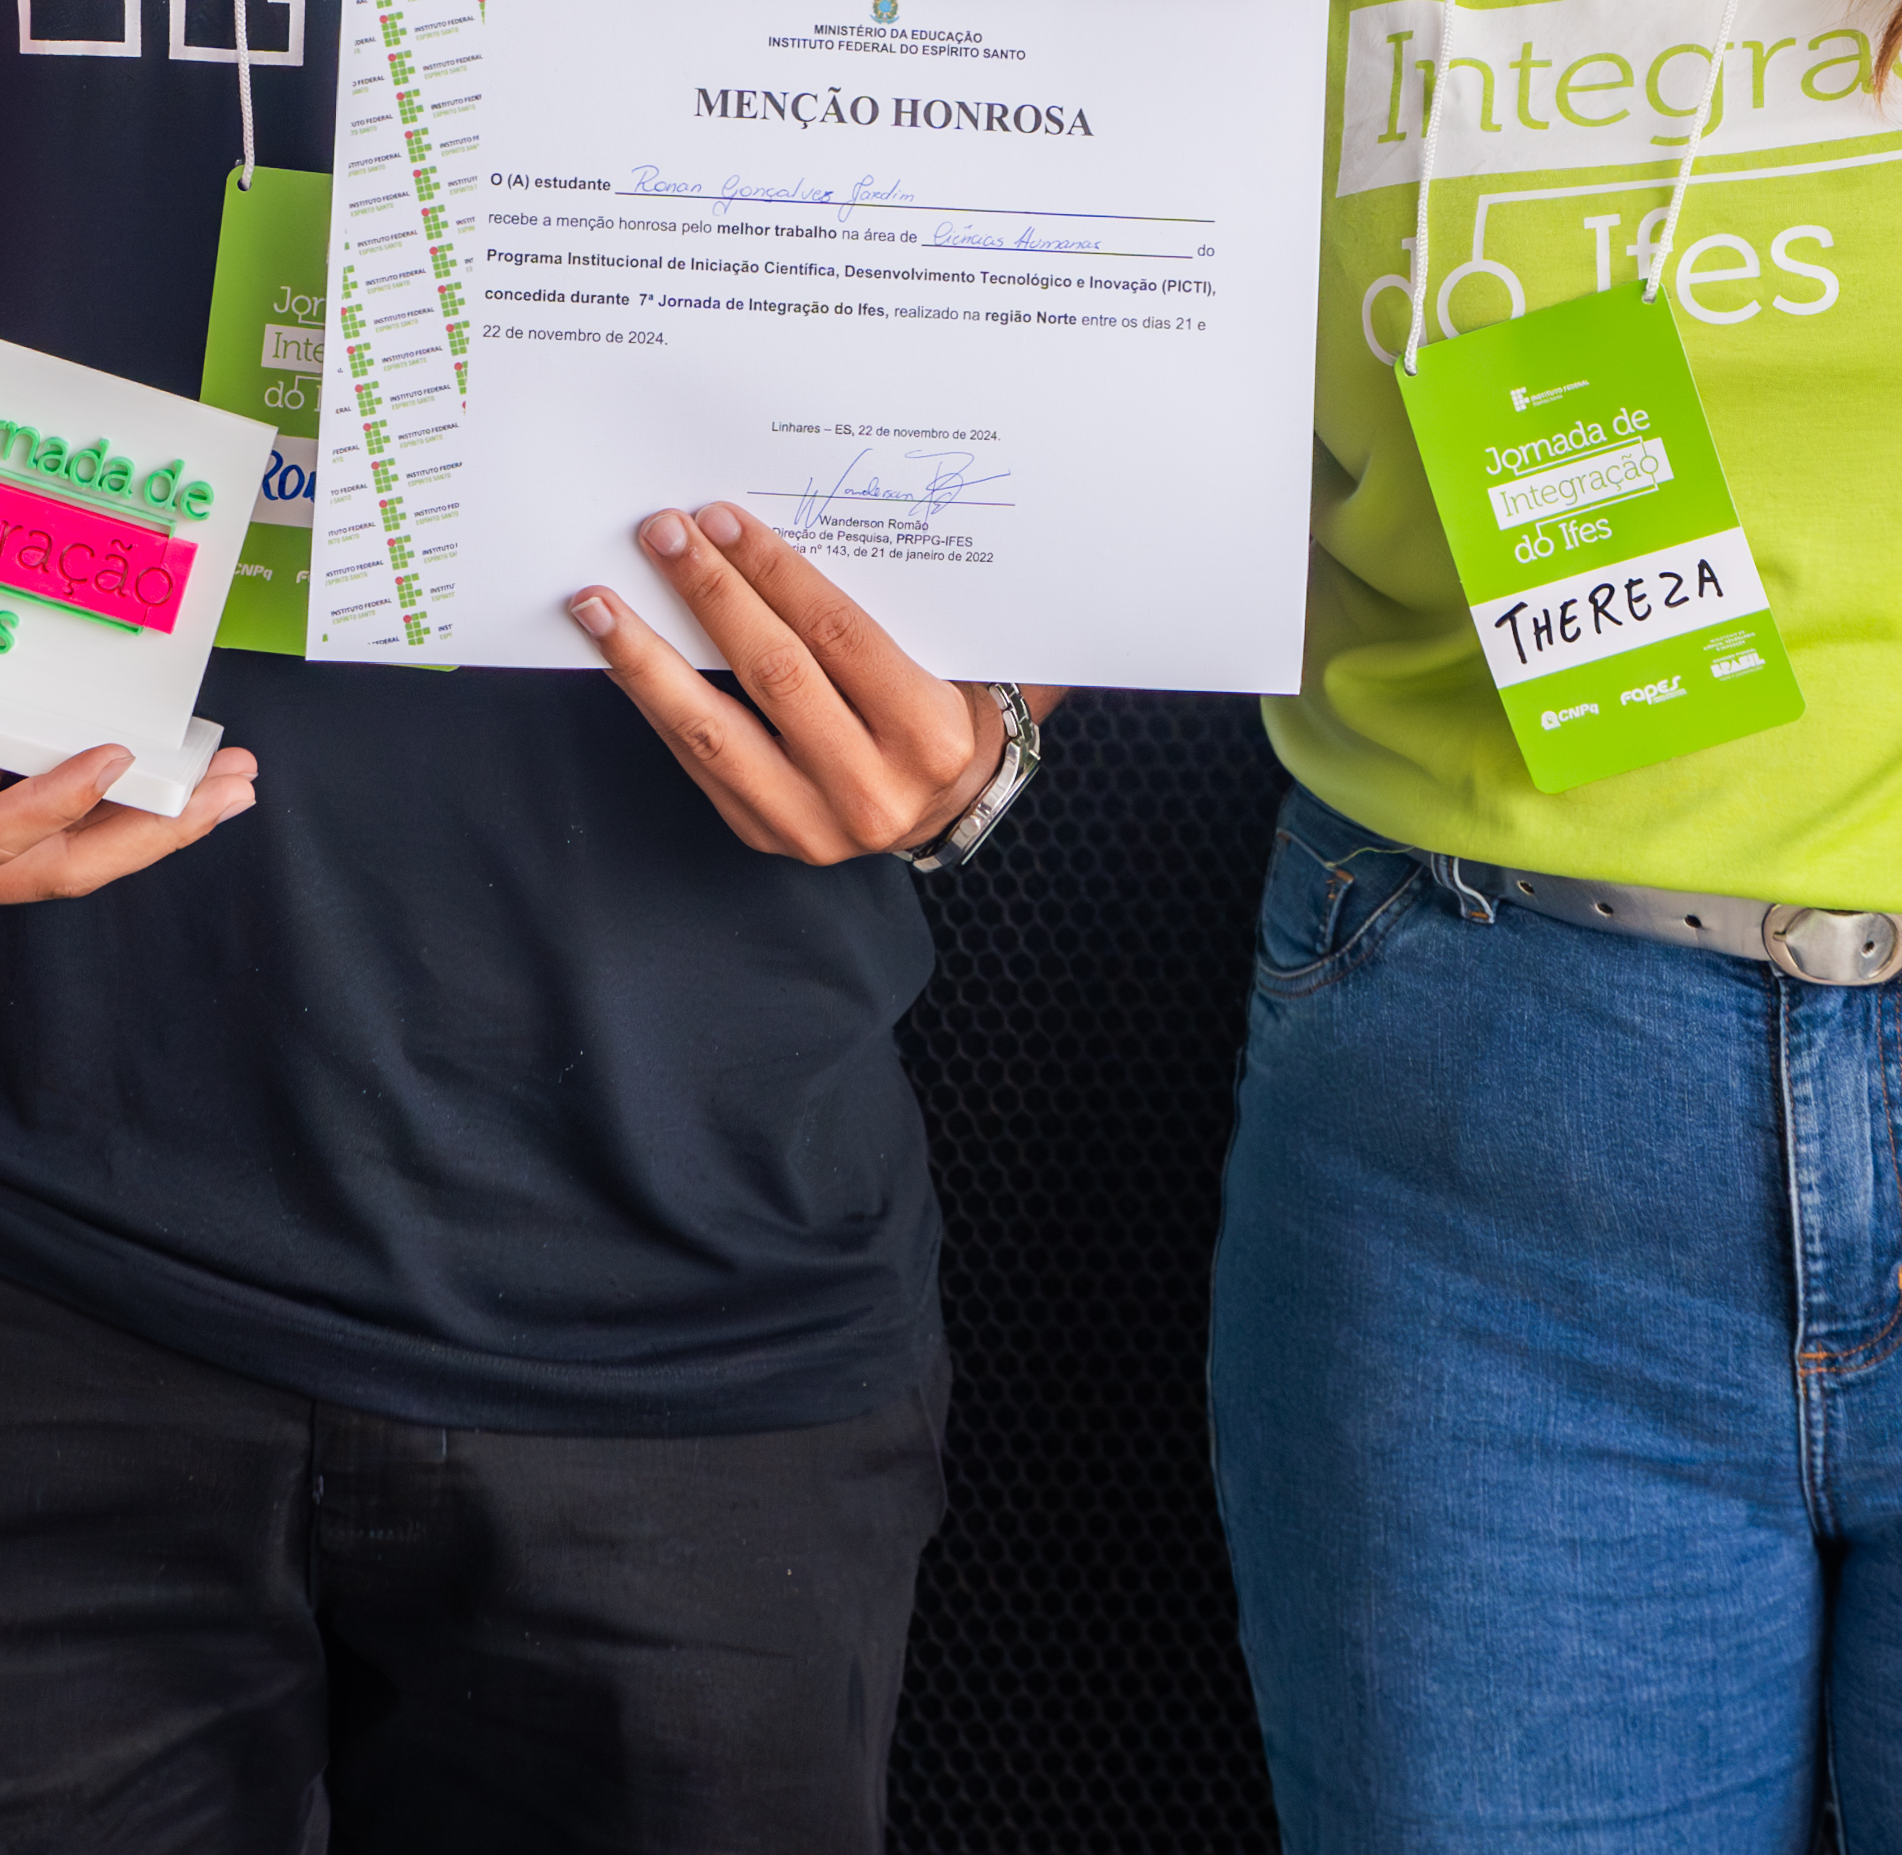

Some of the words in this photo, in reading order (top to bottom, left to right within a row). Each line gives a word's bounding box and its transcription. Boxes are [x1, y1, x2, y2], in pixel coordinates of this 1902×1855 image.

[414, 21, 447, 33] INSTITUTO
[447, 15, 475, 25] FEDERAL
[814, 24, 887, 39] MINISTÉRIO
[890, 28, 908, 39] DA
[910, 29, 983, 44] EDUCAÇÃO
[768, 36, 834, 50] INSTITUTO
[838, 40, 897, 54] FEDERAL
[899, 43, 919, 55] DO
[922, 44, 980, 58] ESPÍRITO
[983, 48, 1026, 61] SANTO
[422, 59, 456, 71] INSTITUTO
[455, 54, 483, 64] FEDERAL
[357, 75, 385, 85] FEDERAL
[430, 98, 464, 110] INSTITUTO
[694, 86, 879, 130] MENÇÃO
[891, 97, 1094, 137] HONROSA
[365, 114, 393, 124] FEDERAL
[490, 172, 503, 186] O
[507, 173, 530, 190] (A)
[534, 176, 611, 191] estudante
[348, 196, 382, 209] INSTITUTO
[382, 191, 410, 201] FEDERAL
[356, 235, 391, 248] INSTITUTO
[390, 229, 418, 240] FEDERAL
[488, 212, 538, 226] recebe
[542, 216, 552, 227] a
[556, 215, 614, 232] menção
[618, 216, 677, 232] honrosa
[681, 220, 712, 236] pelo
[717, 221, 771, 236] melhor
[774, 224, 837, 240] trabalho
[842, 230, 859, 241] na
[863, 228, 895, 242] área
[899, 230, 918, 244] de
[1197, 243, 1215, 257] do
[365, 274, 398, 286] INSTITUTO
[398, 268, 426, 279] FEDERAL
[486, 248, 563, 266] Programa
[567, 251, 663, 269] Institucional
[667, 256, 686, 270] de
[690, 257, 759, 276] Iniciação
[764, 261, 839, 279] Científica,
[844, 264, 975, 284] Desenvolvimento
[979, 270, 1072, 290] Tecnológico
[1076, 278, 1085, 288] e
[1089, 275, 1157, 294] Inovação
[1161, 279, 1216, 297] (PICTI),
[373, 312, 407, 325] INSTITUTO
[406, 307, 435, 317] FEDERAL
[484, 288, 565, 303] concedida
[570, 290, 630, 306] durante
[639, 293, 654, 306] 7ª
[657, 294, 721, 310] Jornada
[725, 297, 744, 311] de
[749, 297, 830, 317] Integração
[834, 301, 853, 315] do
[858, 302, 889, 319] Ifes,
[894, 305, 959, 320] realizado
[963, 310, 980, 321] na
[985, 309, 1032, 326] região
[1036, 310, 1077, 325] Norte
[1081, 314, 1117, 327] entre
[1121, 317, 1138, 328] os
[1142, 316, 1171, 330] dias
[1175, 316, 1191, 330] 21
[1197, 321, 1206, 331] e
[482, 324, 501, 338] 22
[505, 326, 524, 339] de
[528, 328, 601, 343] novembro
[605, 330, 624, 344] de
[628, 330, 668, 346] 2024.
[381, 351, 415, 363] INSTITUTO
[414, 346, 443, 356] FEDERAL
[263, 381, 305, 411] do
[389, 389, 423, 402] INSTITUTO
[423, 384, 451, 394] FEDERAL
[397, 428, 431, 440] INSTITUTO
[431, 422, 459, 433] FEDERAL
[771, 421, 821, 434] Linhares
[834, 423, 855, 437] ES,
[857, 424, 873, 436] 22
[875, 426, 890, 437] de
[893, 428, 950, 439] novembro
[952, 429, 967, 440] de
[969, 429, 1001, 441] 2024.
[332, 444, 360, 455] FEDERAL
[1485, 420, 1607, 476] Jornada
[1612, 407, 1651, 437] de
[405, 466, 439, 479] INSTITUTO
[143, 458, 215, 521] de
[340, 483, 368, 493] FEDERAL
[1498, 453, 1659, 518] Integração
[819, 515, 884, 529] Wanderson
[887, 518, 929, 531] Romão
[818, 530, 834, 541] de
[836, 530, 893, 545] Pesquisa,
[896, 533, 973, 548] PRPPG-IFES
[1514, 533, 1555, 565] do
[1564, 516, 1613, 551] Ifes
[809, 543, 823, 554] nº
[826, 544, 850, 558] 143,
[853, 546, 868, 557] de
[870, 546, 885, 558] 21
[888, 547, 903, 559] de
[905, 548, 945, 562] janeiro
[947, 550, 962, 562] de
[965, 551, 994, 563] 2022
[330, 604, 364, 616] INSTITUTO
[364, 598, 392, 609] FEDERAL
[1494, 558, 1725, 666] THEREZA
